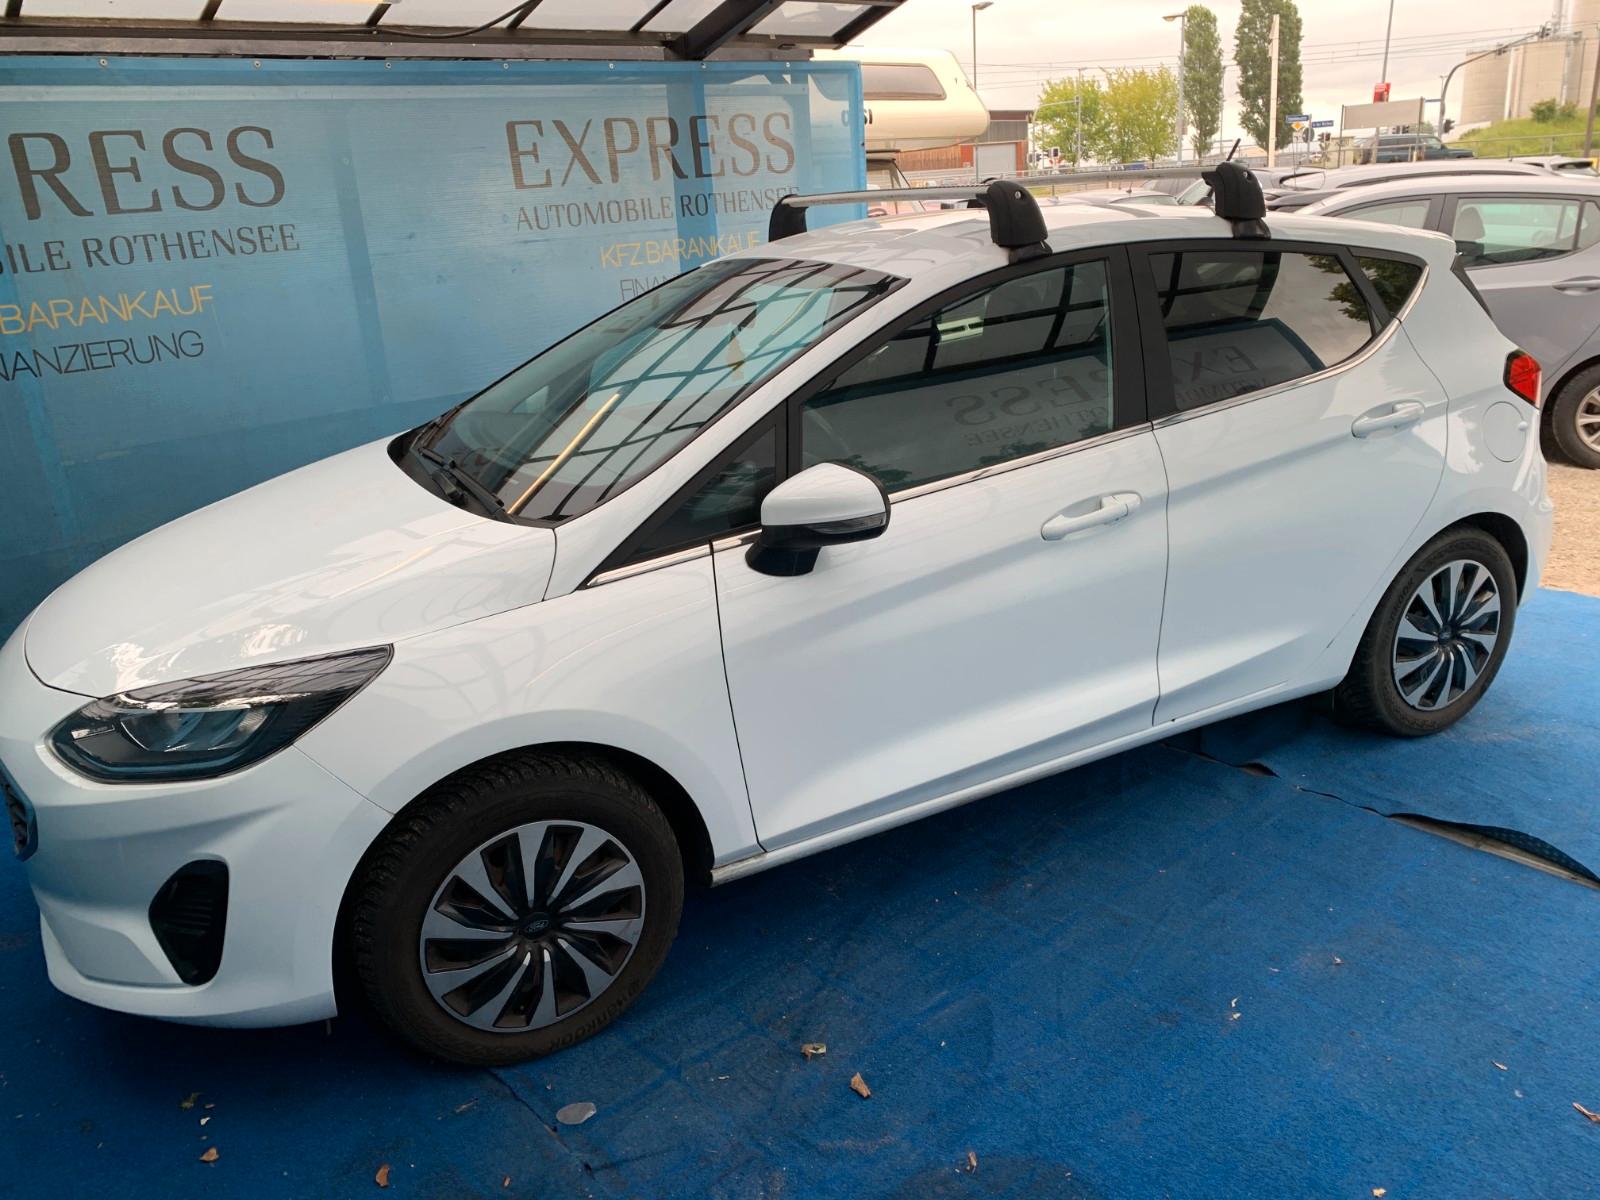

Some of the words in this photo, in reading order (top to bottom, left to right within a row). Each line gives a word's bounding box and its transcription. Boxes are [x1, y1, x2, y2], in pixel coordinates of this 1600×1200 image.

[8, 125, 285, 220] RESS
[506, 112, 795, 190] EXPRESS
[516, 195, 674, 232] AUTOMOBILE
[0, 239, 71, 275] ILE
[82, 223, 301, 269] ROTHENSEE
[600, 241, 641, 269] KFZ
[645, 230, 761, 263] BARANKAUF
[0, 284, 214, 334] BARANKAUF
